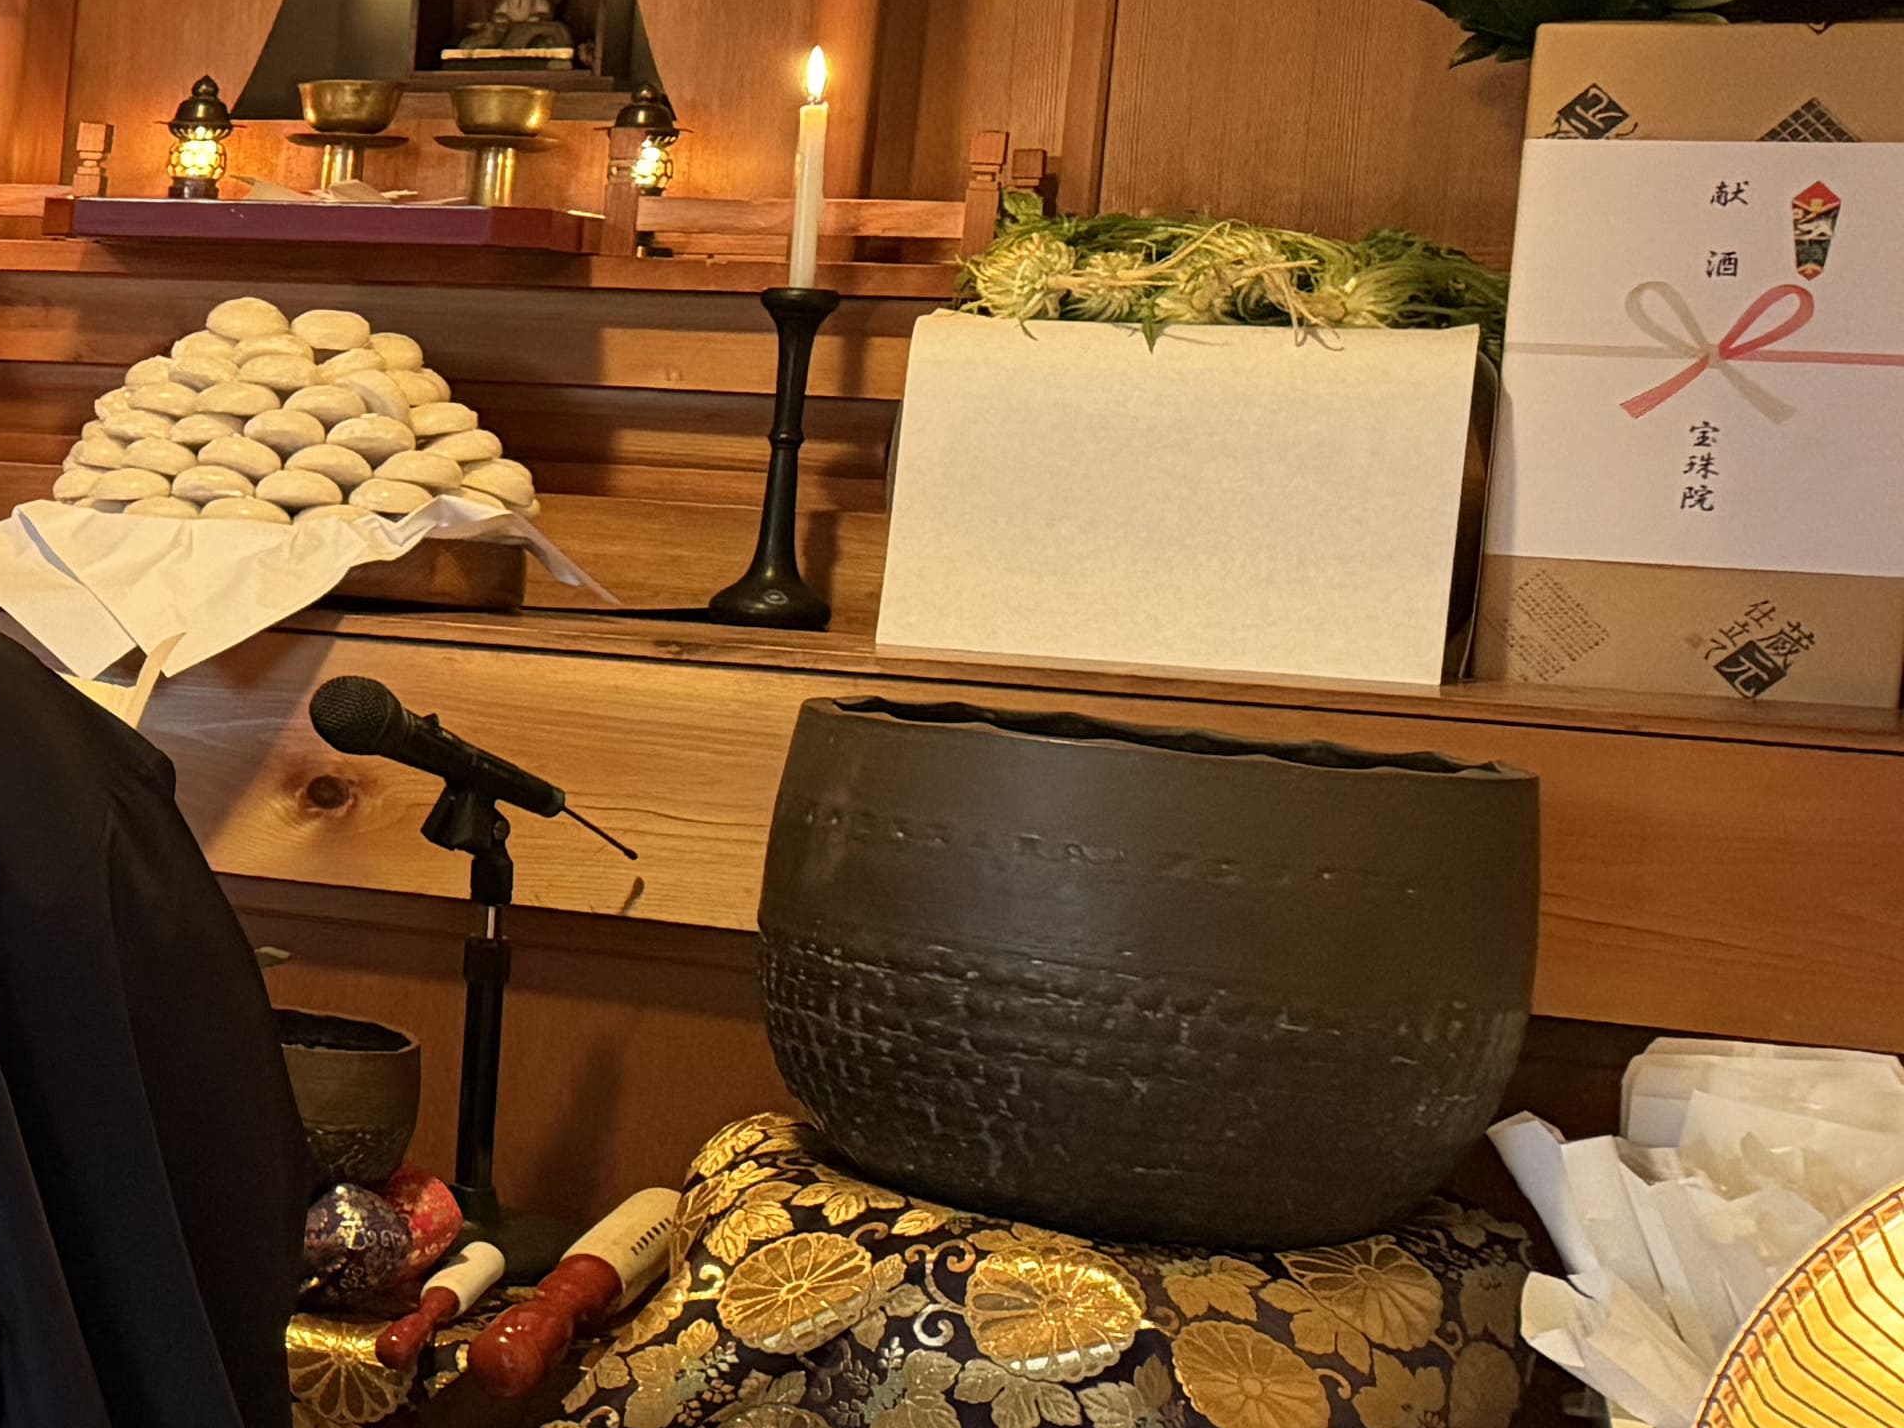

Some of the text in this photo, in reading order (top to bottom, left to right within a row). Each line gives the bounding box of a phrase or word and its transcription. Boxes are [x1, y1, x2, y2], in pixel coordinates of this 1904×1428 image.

[1706, 180, 1750, 279] 献酒
[1680, 420, 1721, 512] 宝珠院
[1704, 600, 1777, 661] 仕立て
[1713, 621, 1816, 700] 蔵元
